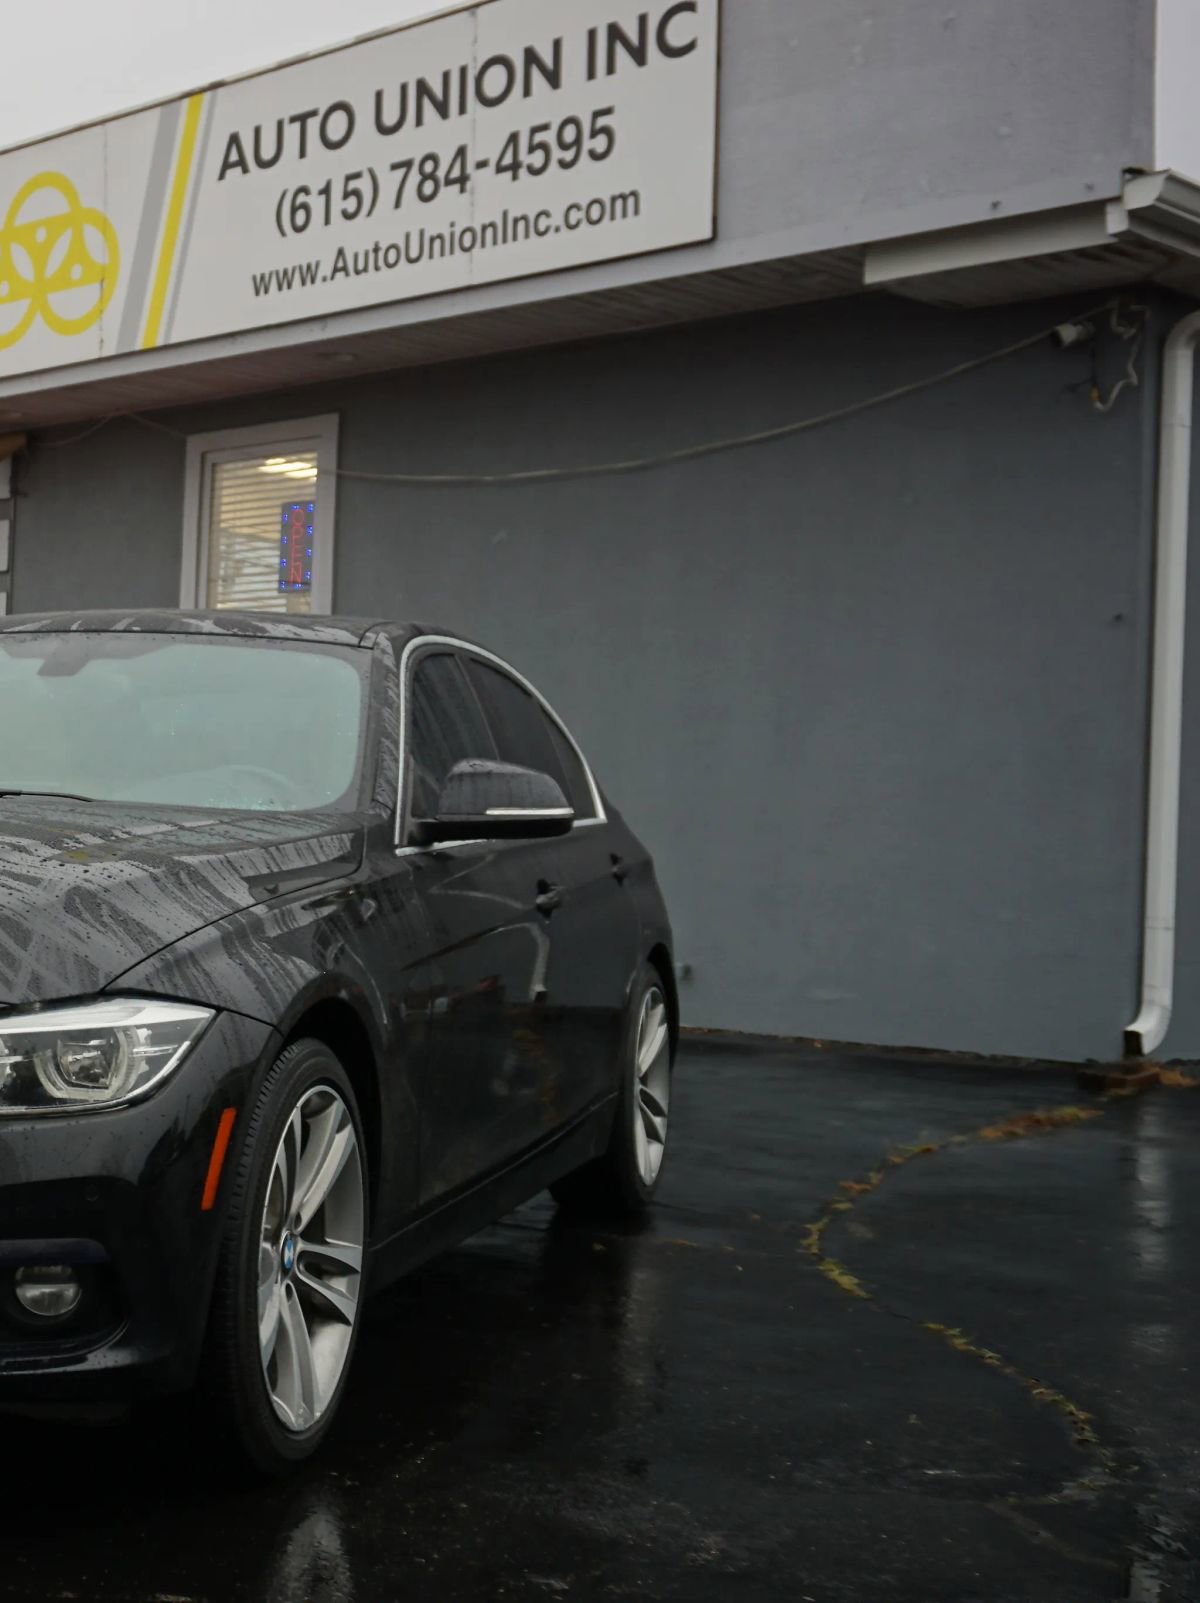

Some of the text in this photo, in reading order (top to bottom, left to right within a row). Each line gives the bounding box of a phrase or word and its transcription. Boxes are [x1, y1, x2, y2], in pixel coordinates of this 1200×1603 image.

[216, 0, 700, 183] AUTO UNION INC
[274, 105, 617, 239] (615) 784-4595
[251, 188, 641, 298] www.AutoUnionInc.com
[290, 509, 305, 584] OPEN
